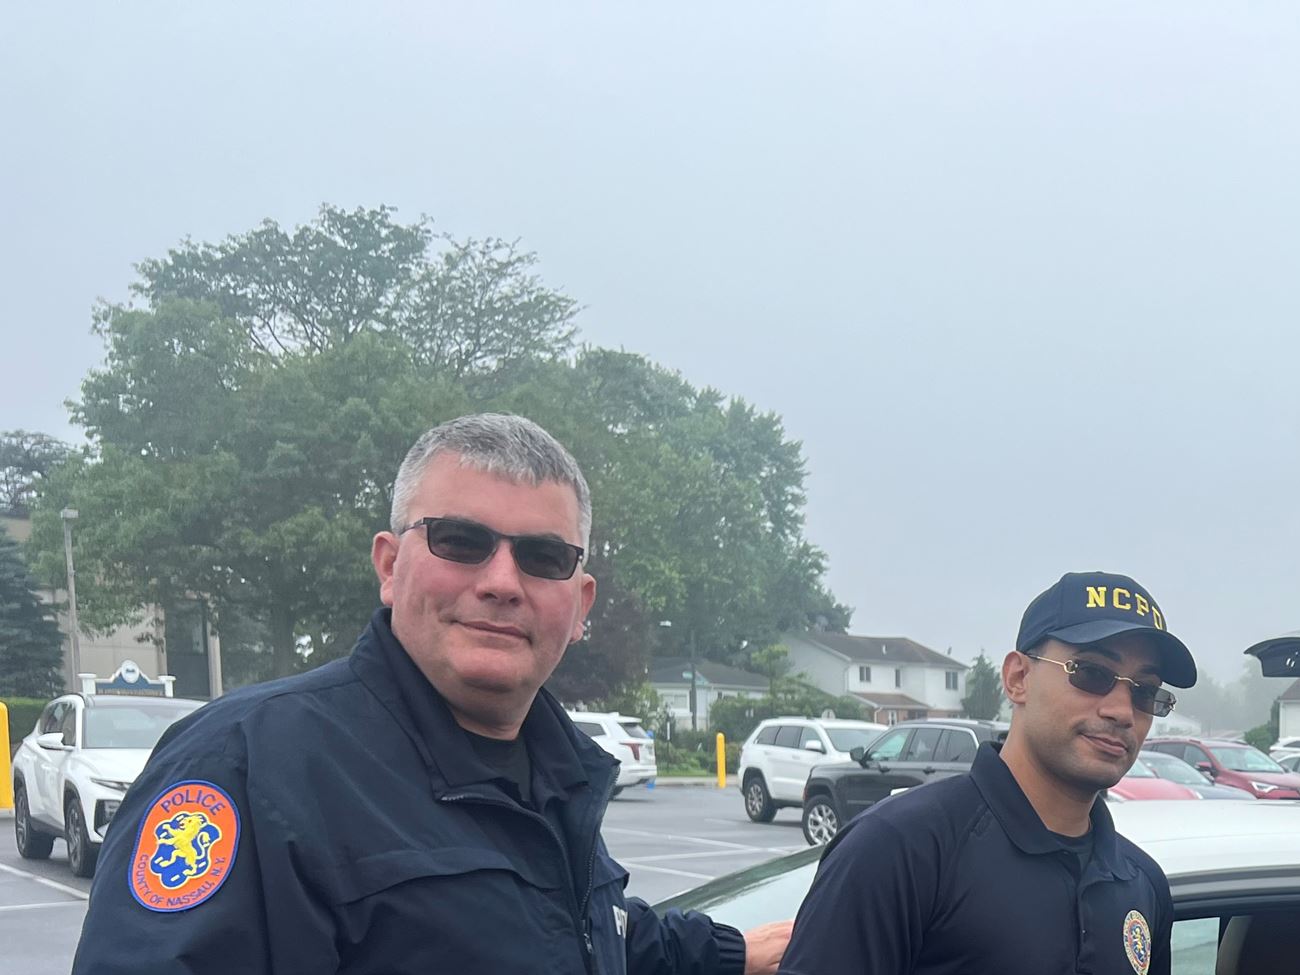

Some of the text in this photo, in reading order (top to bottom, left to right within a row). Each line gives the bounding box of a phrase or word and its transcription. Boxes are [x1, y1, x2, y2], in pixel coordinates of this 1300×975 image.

[1086, 586, 1163, 630] NCPD
[160, 789, 225, 815] POLICE
[135, 854, 150, 897] COUNTY
[149, 893, 164, 905] OF
